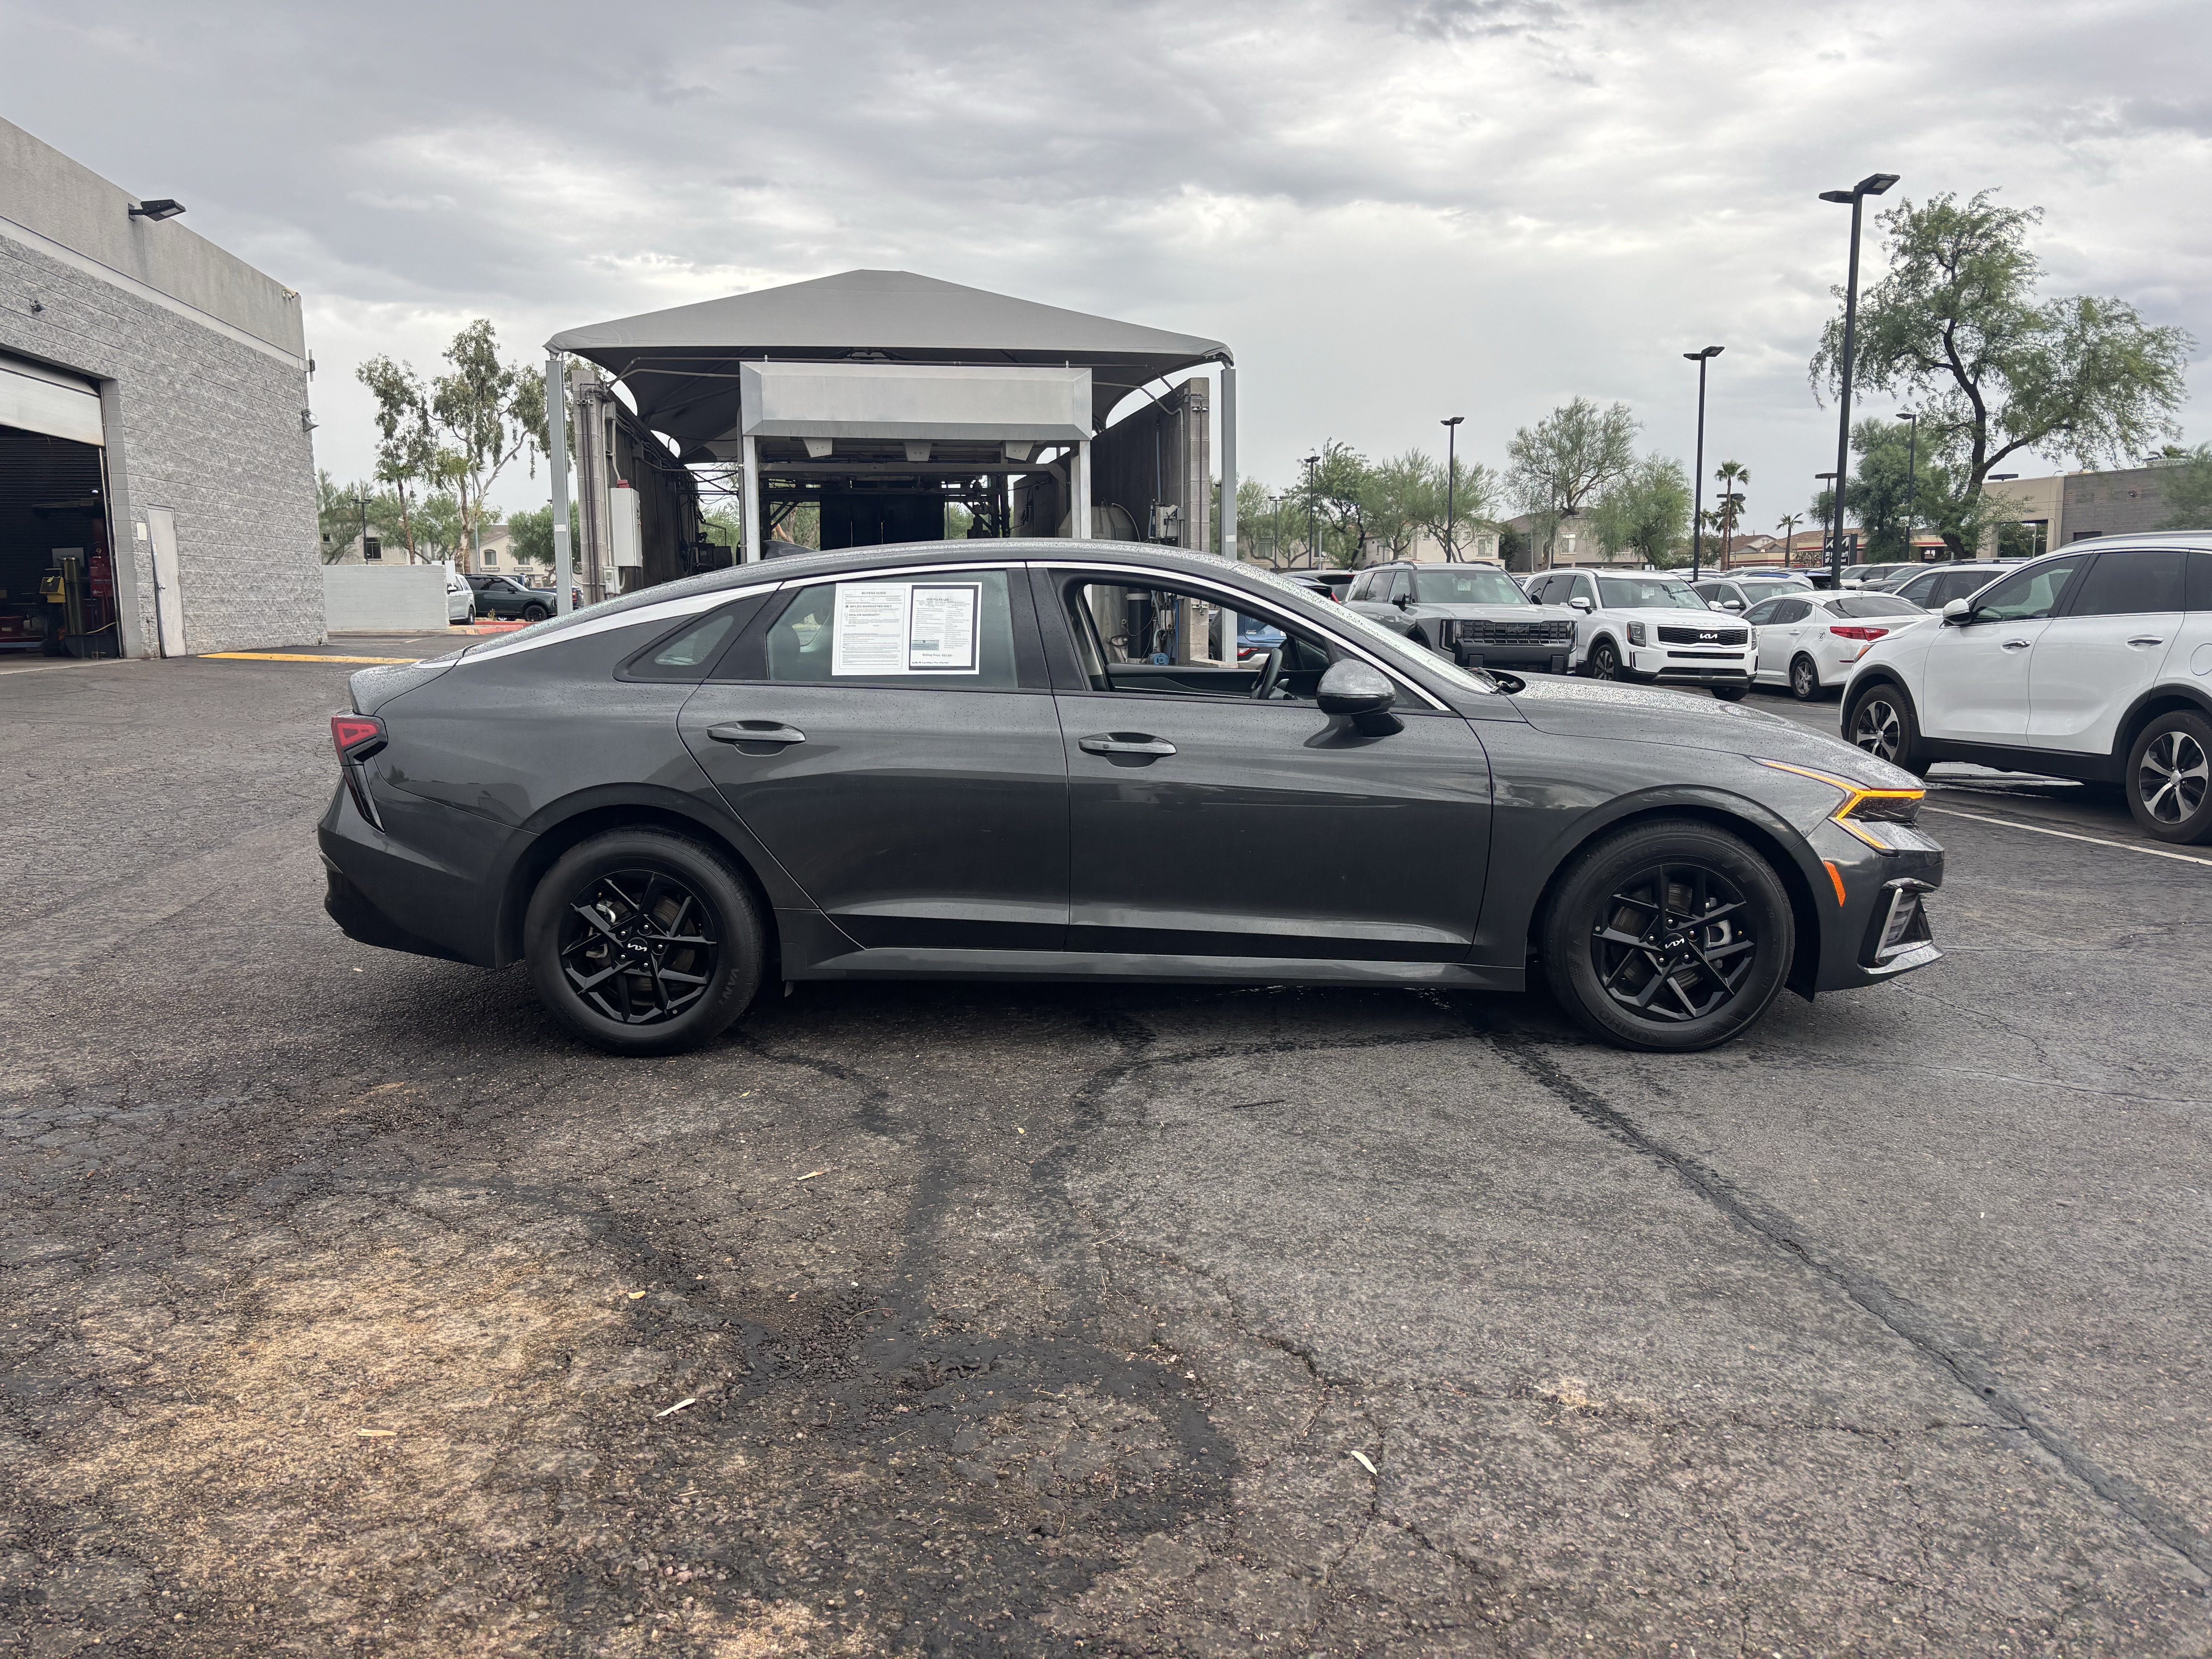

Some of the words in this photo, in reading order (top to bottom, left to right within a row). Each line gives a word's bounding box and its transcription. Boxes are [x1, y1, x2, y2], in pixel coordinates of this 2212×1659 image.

[1826, 537, 1850, 549] KA
[627, 943, 647, 951] KIA
[1664, 938, 1685, 949] KIA
